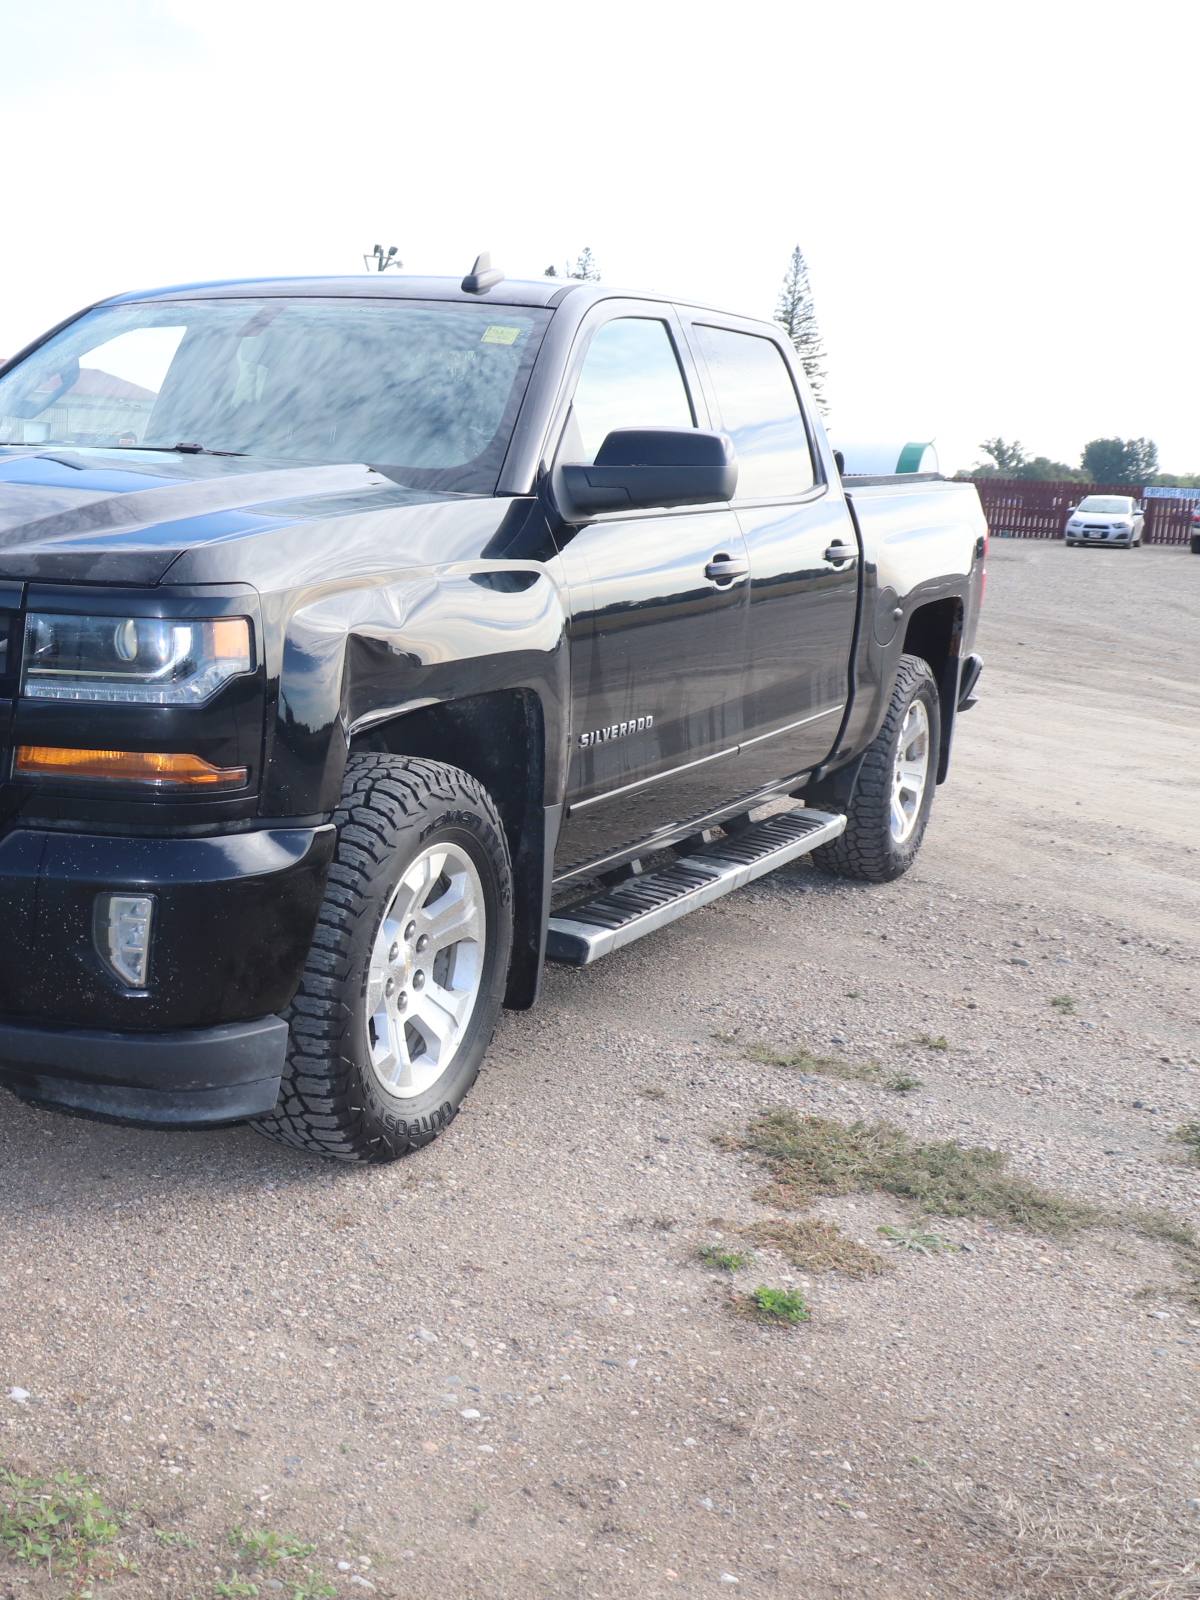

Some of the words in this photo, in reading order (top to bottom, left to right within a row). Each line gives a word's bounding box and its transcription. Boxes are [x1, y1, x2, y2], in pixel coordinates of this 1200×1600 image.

[1146, 487, 1178, 498] EMPLOYEE
[578, 715, 653, 748] SILVERADO
[375, 1101, 452, 1138] OUTPOST
